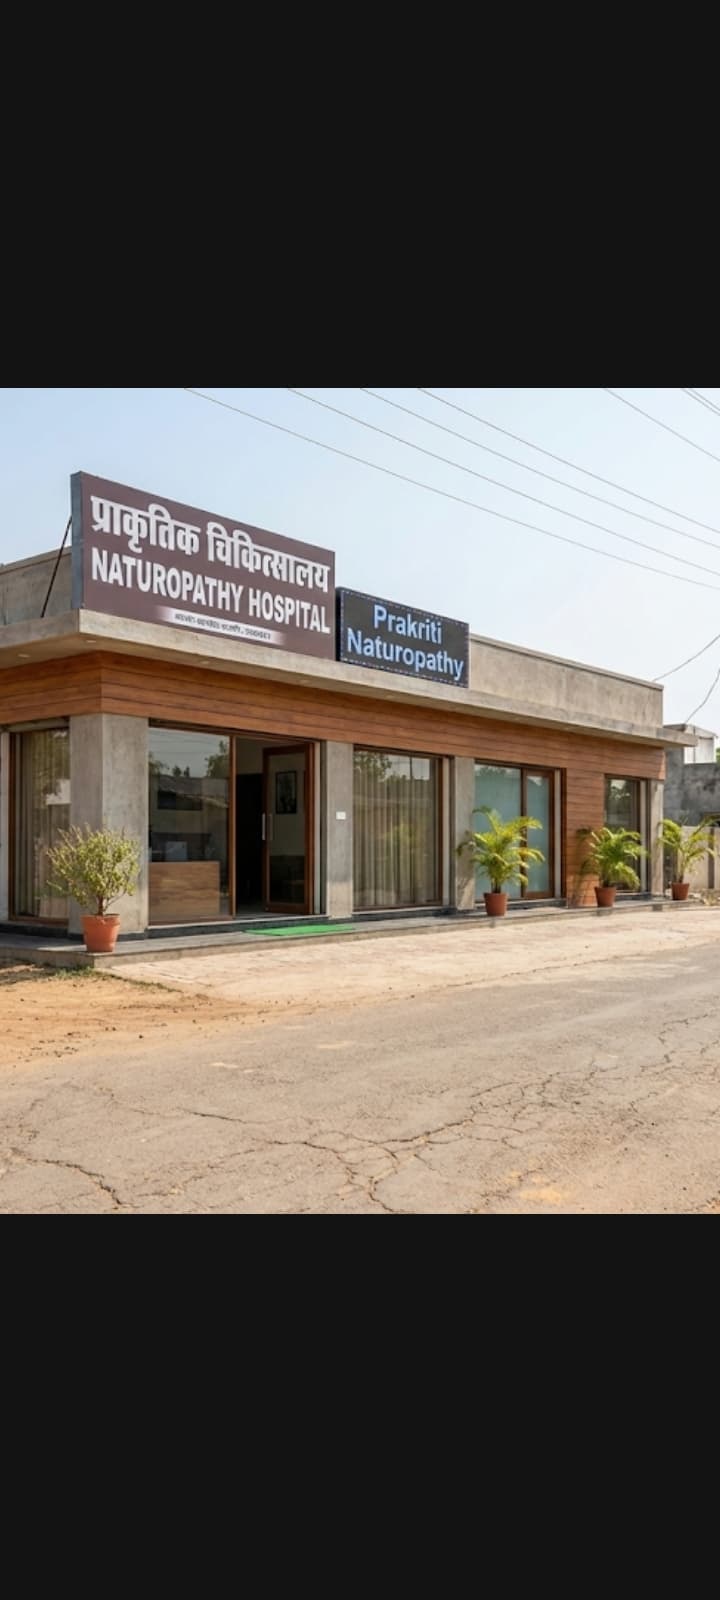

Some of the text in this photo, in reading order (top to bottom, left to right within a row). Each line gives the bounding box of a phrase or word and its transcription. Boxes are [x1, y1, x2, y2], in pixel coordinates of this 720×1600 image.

[90, 495, 331, 593] प्राकृतिक चिकित्सालय
[91, 547, 243, 614] NATUROPATHY
[248, 587, 331, 634] HOSPITAL
[372, 604, 443, 645] Prakriti
[347, 627, 464, 681] Naturopathy
